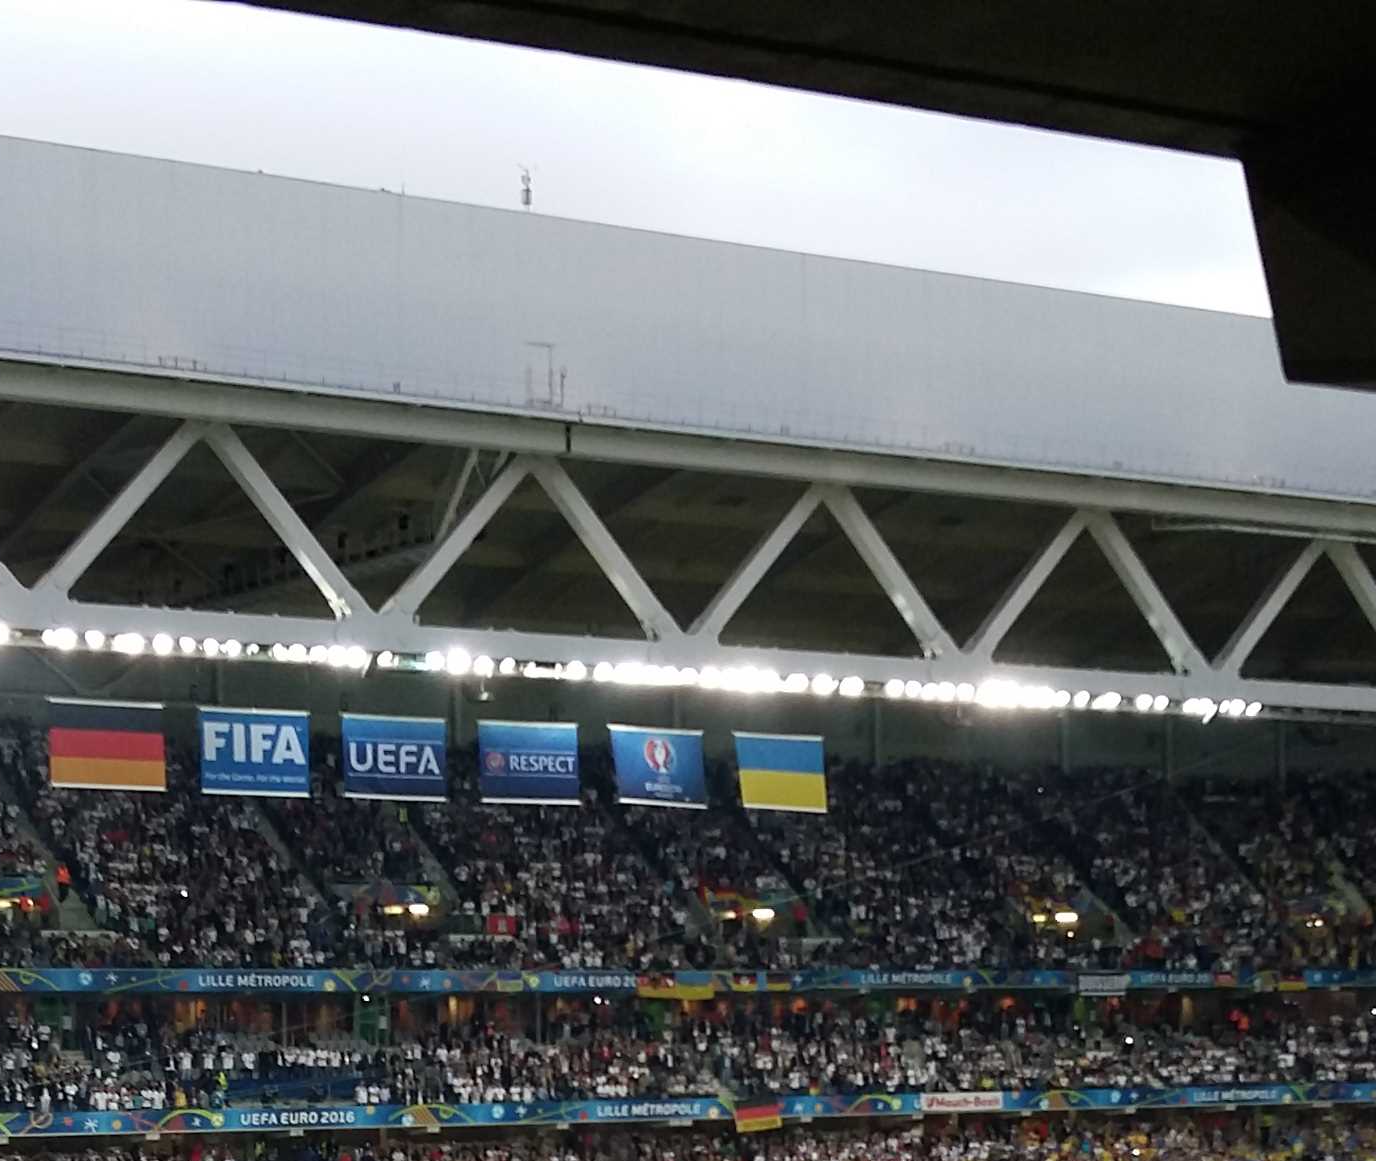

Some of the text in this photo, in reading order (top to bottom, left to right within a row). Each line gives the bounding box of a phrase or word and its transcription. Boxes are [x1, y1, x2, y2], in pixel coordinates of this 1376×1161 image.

[202, 721, 307, 765] FIFA
[349, 742, 440, 775] UEFA
[509, 754, 575, 773] RESPECT
[198, 973, 315, 987] LILLE MÉTROPOLE
[553, 975, 586, 987] UEFA
[589, 975, 621, 987] EURO
[596, 1102, 701, 1117] LILLE MÉTROPOLE
[240, 1110, 356, 1125] UEFA EURO 2016
